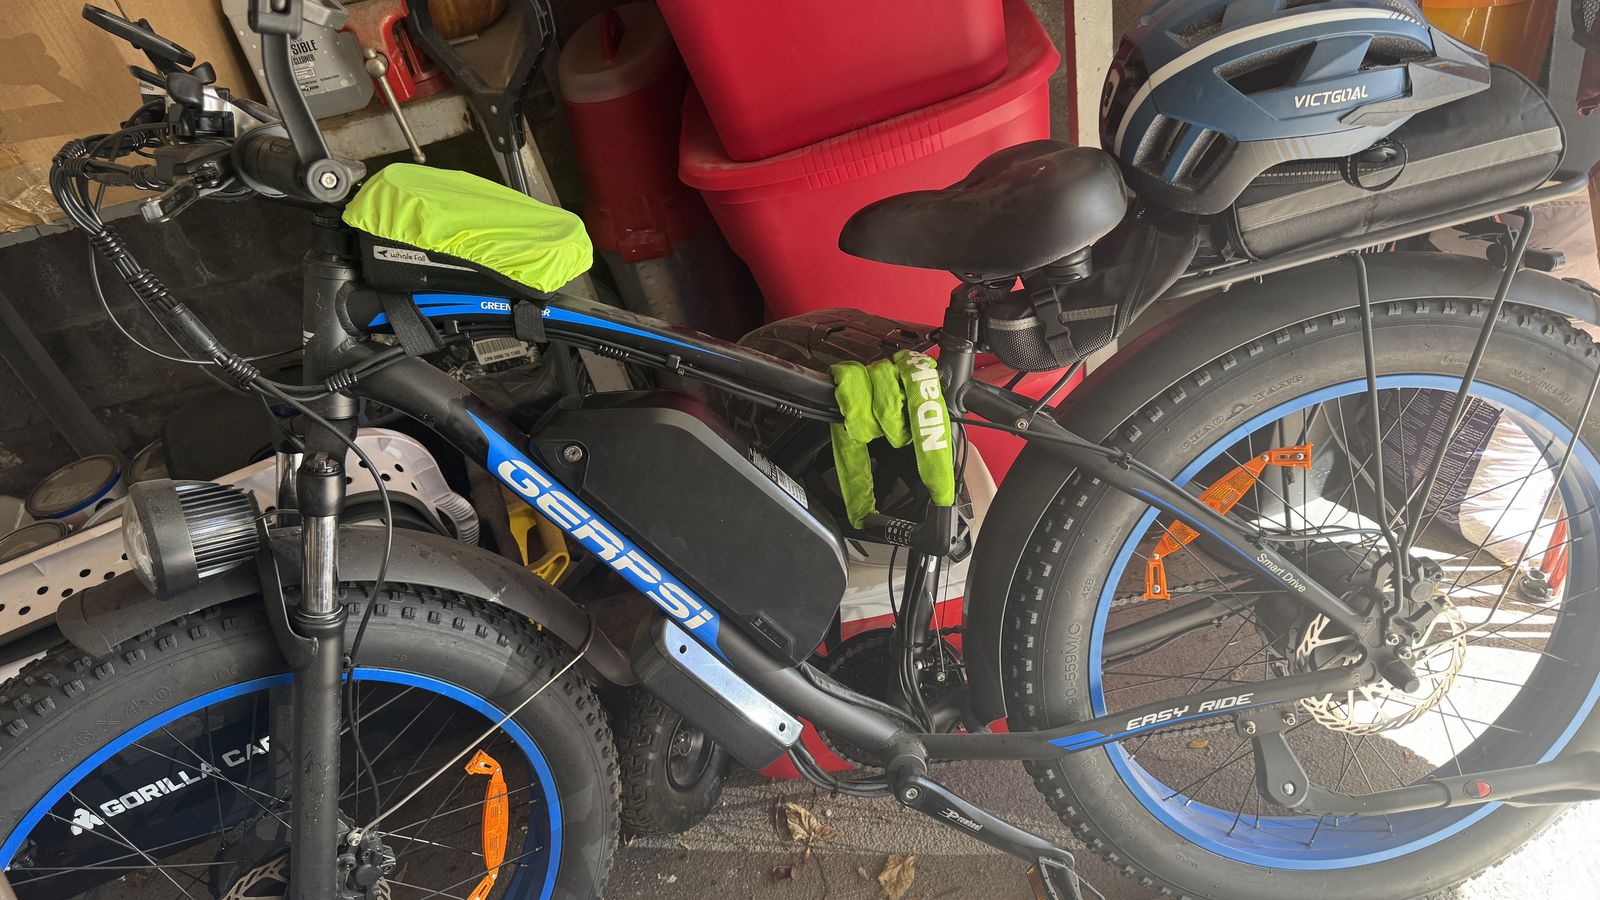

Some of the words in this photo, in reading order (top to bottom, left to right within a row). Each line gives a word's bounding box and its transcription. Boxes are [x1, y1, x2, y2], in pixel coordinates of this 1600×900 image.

[290, 40, 318, 55] SIBLE
[1294, 84, 1369, 109] VICTGOAL
[390, 252, 413, 261] whale
[414, 254, 426, 262] fall
[480, 301, 512, 312] GREEN
[1257, 553, 1285, 576] Smart
[1282, 572, 1306, 592] Drive
[1126, 705, 1190, 731] EASY
[1198, 692, 1254, 713] RIDE
[100, 762, 222, 817] GORILLA
